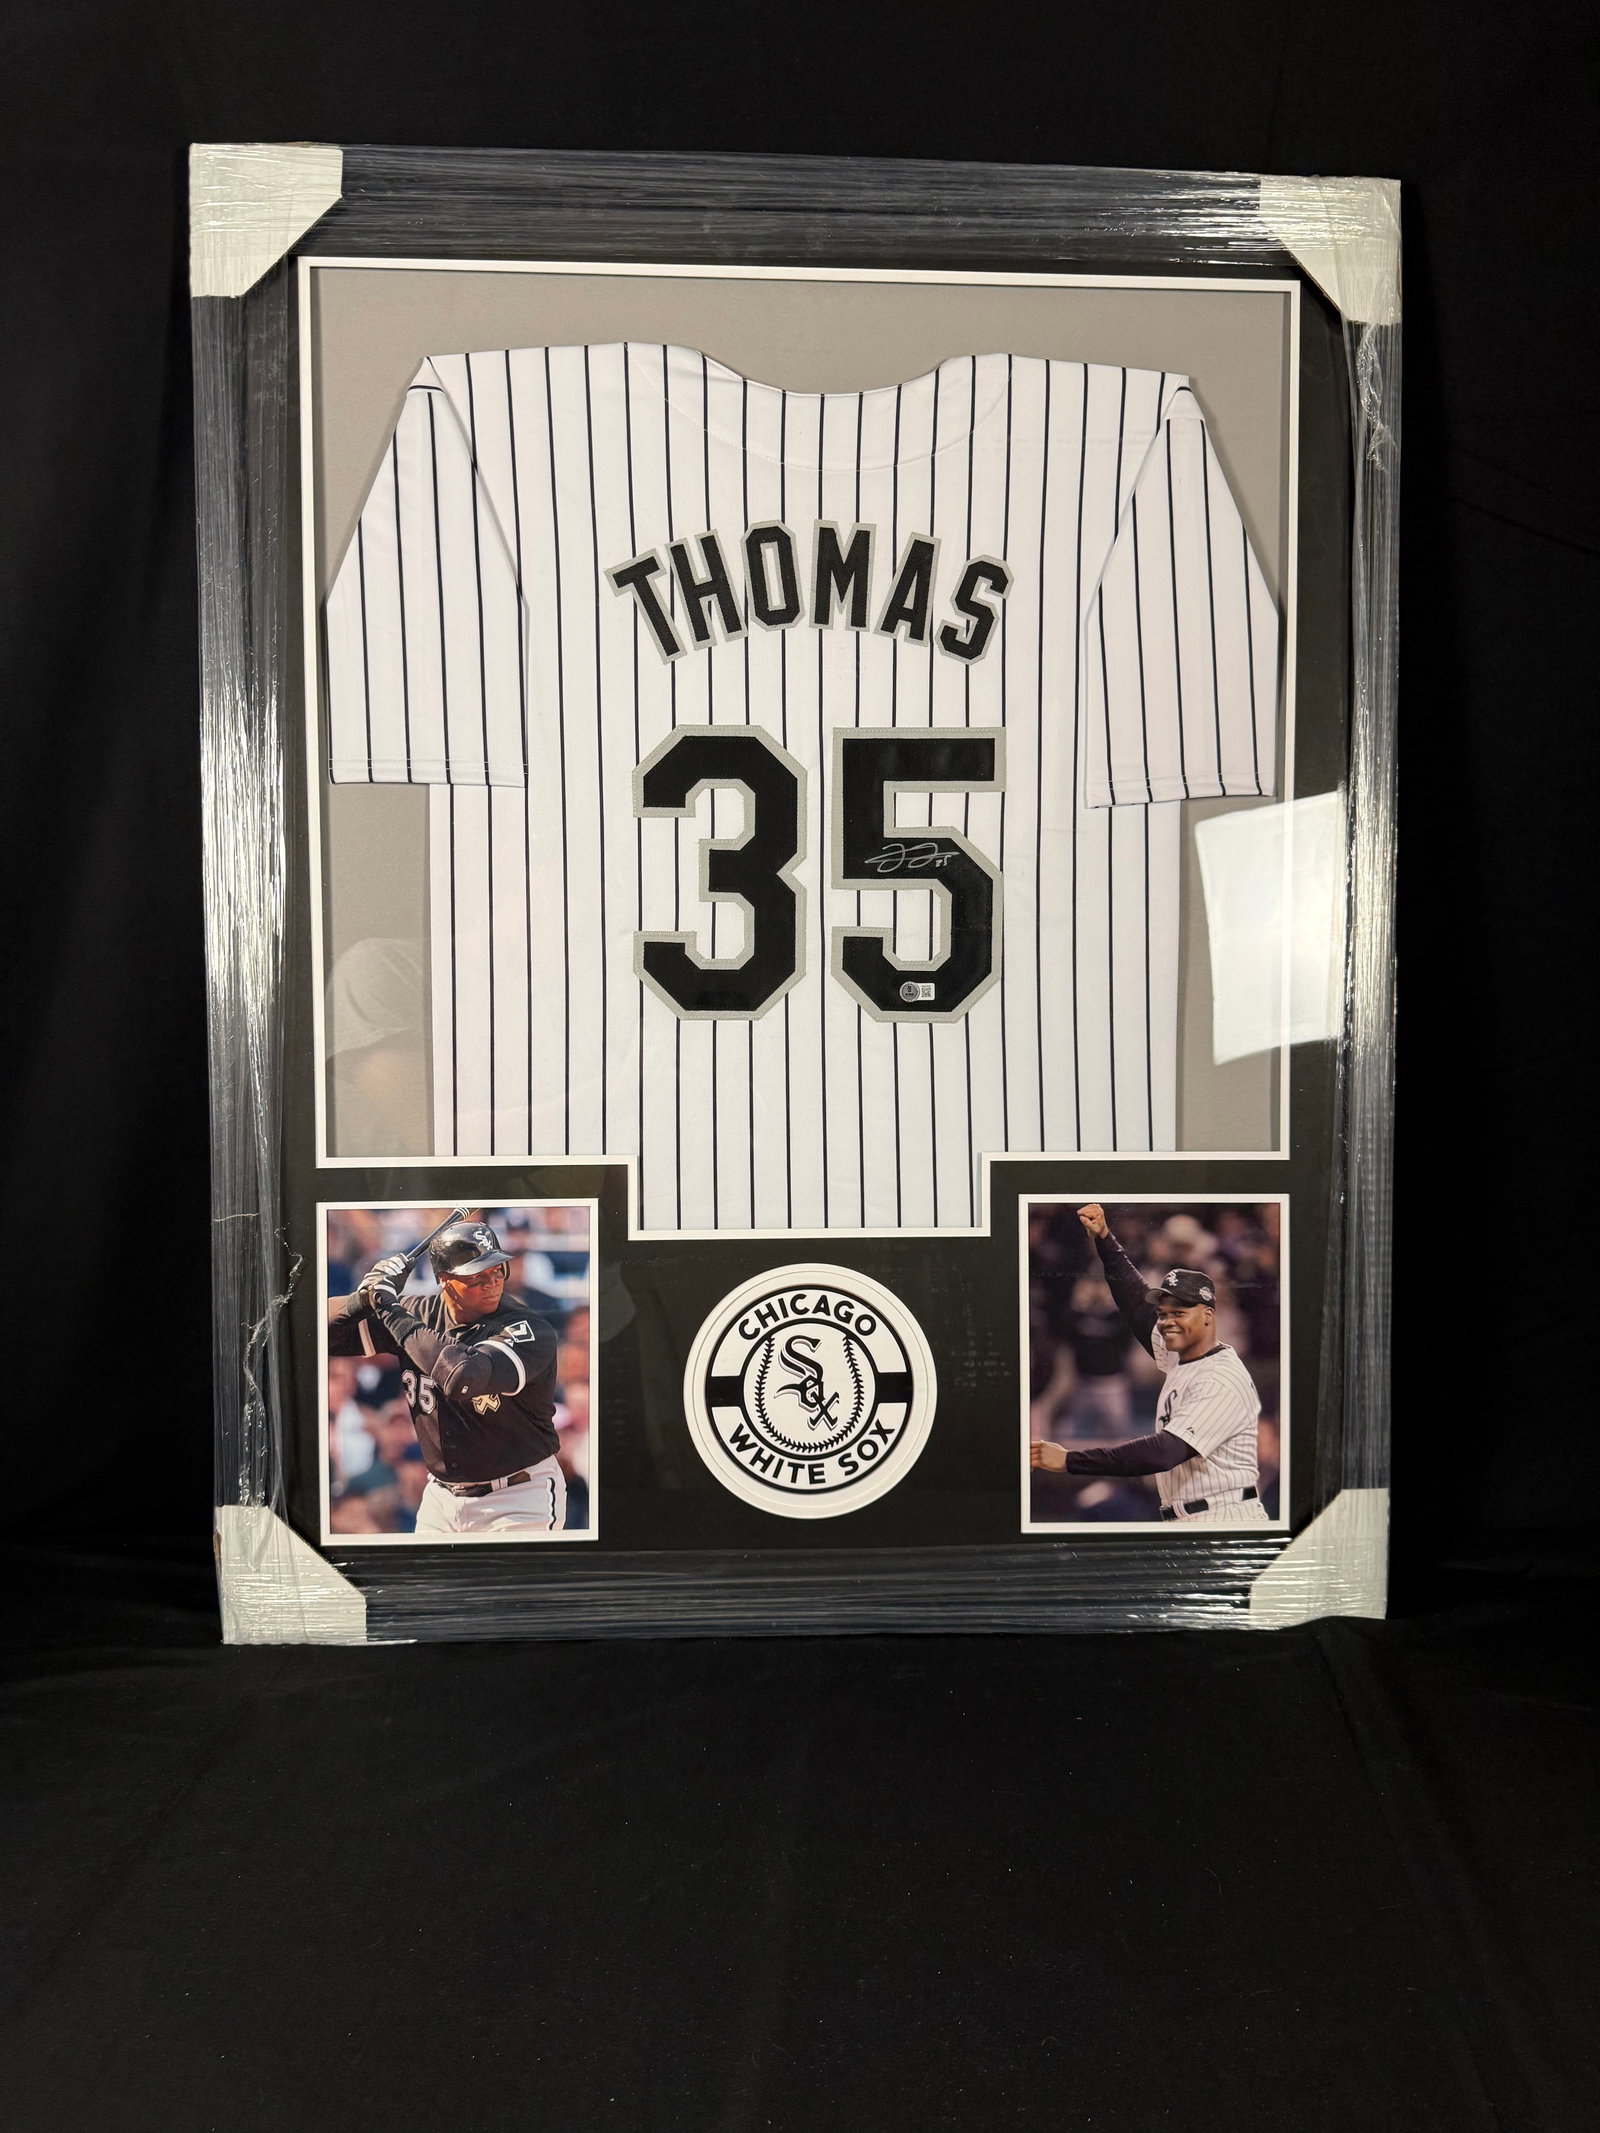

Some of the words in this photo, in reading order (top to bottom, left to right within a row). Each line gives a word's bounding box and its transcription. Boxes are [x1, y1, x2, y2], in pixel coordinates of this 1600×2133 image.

[604, 519, 1014, 665] THOMAS
[632, 724, 1006, 1023] 35
[738, 1293, 877, 1341] CHICAGO
[401, 1369, 437, 1415] 35
[729, 1423, 827, 1485] WHITE
[837, 1418, 896, 1477] SOX
